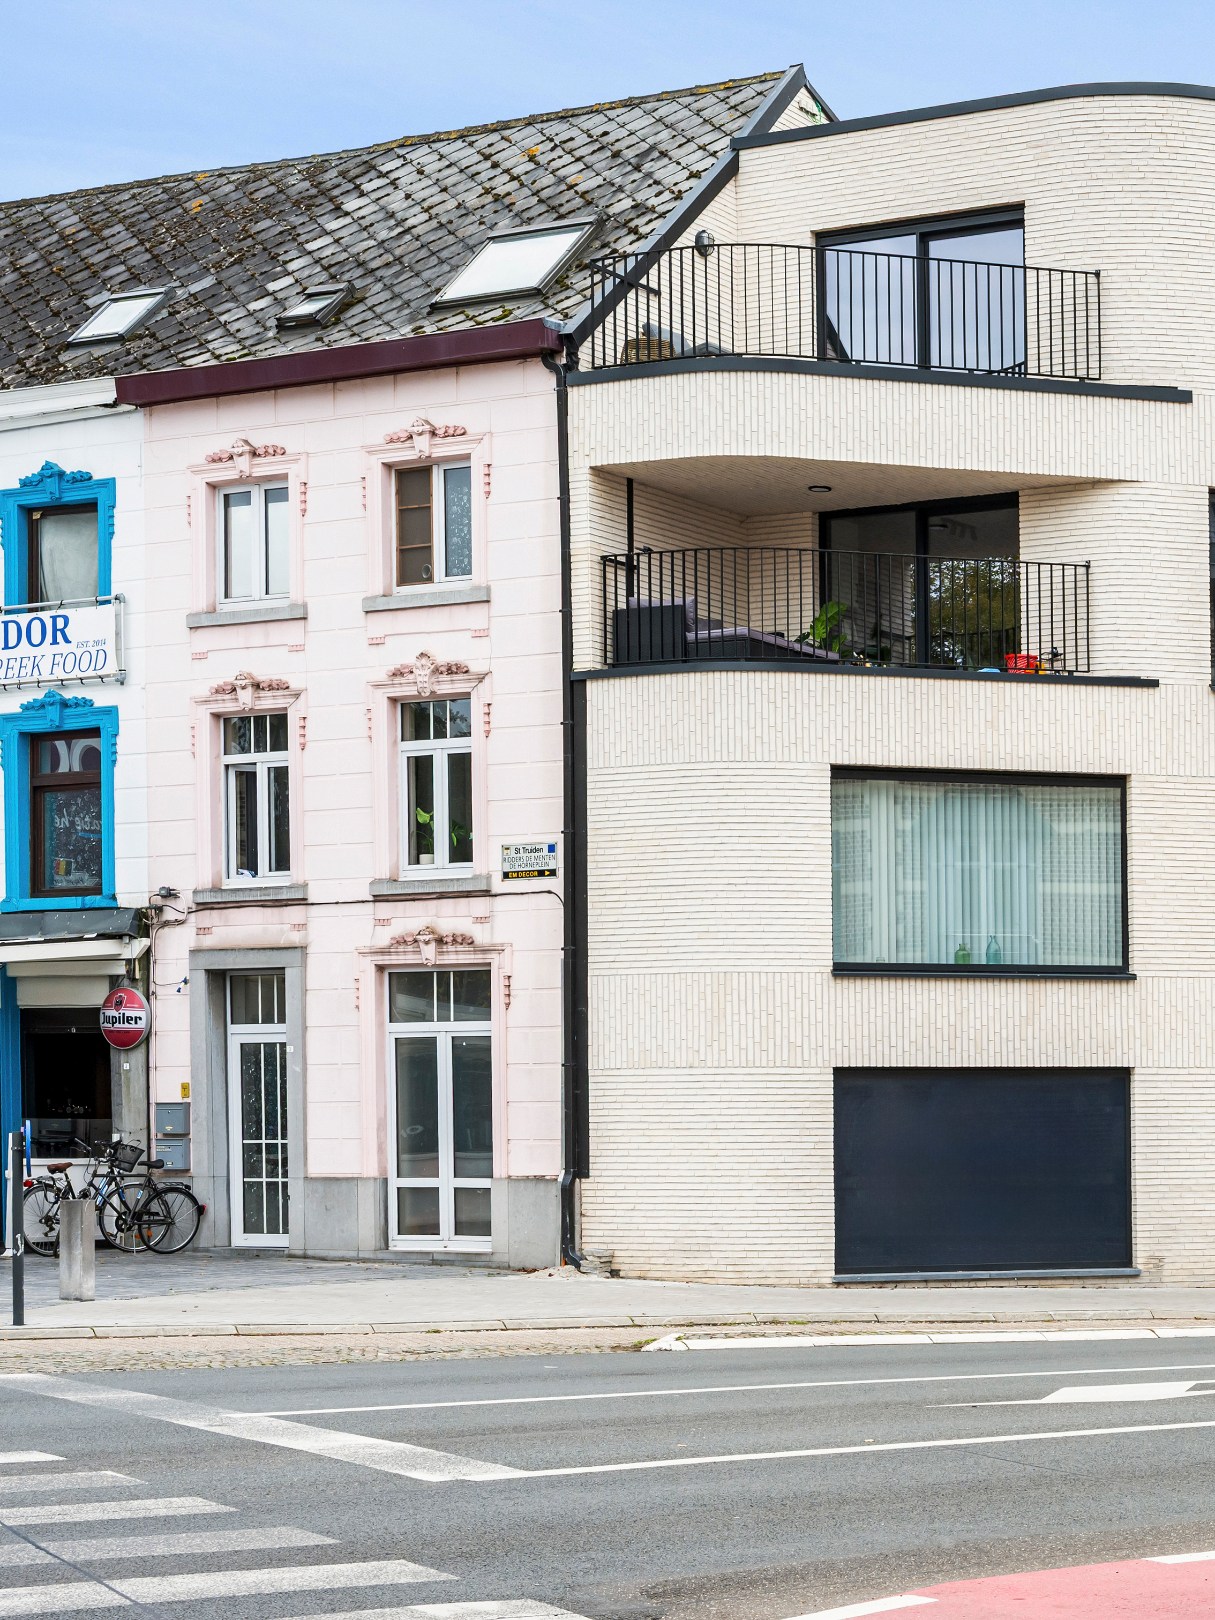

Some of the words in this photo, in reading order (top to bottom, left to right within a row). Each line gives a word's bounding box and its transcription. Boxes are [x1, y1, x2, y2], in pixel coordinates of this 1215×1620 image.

[1, 615, 72, 650] DOR
[76, 641, 91, 649] EST.
[91, 638, 107, 648] 2014
[49, 649, 108, 675] FOOD
[514, 847, 521, 855] St
[522, 846, 544, 854] Truiden
[101, 1011, 143, 1028] Jupiler
